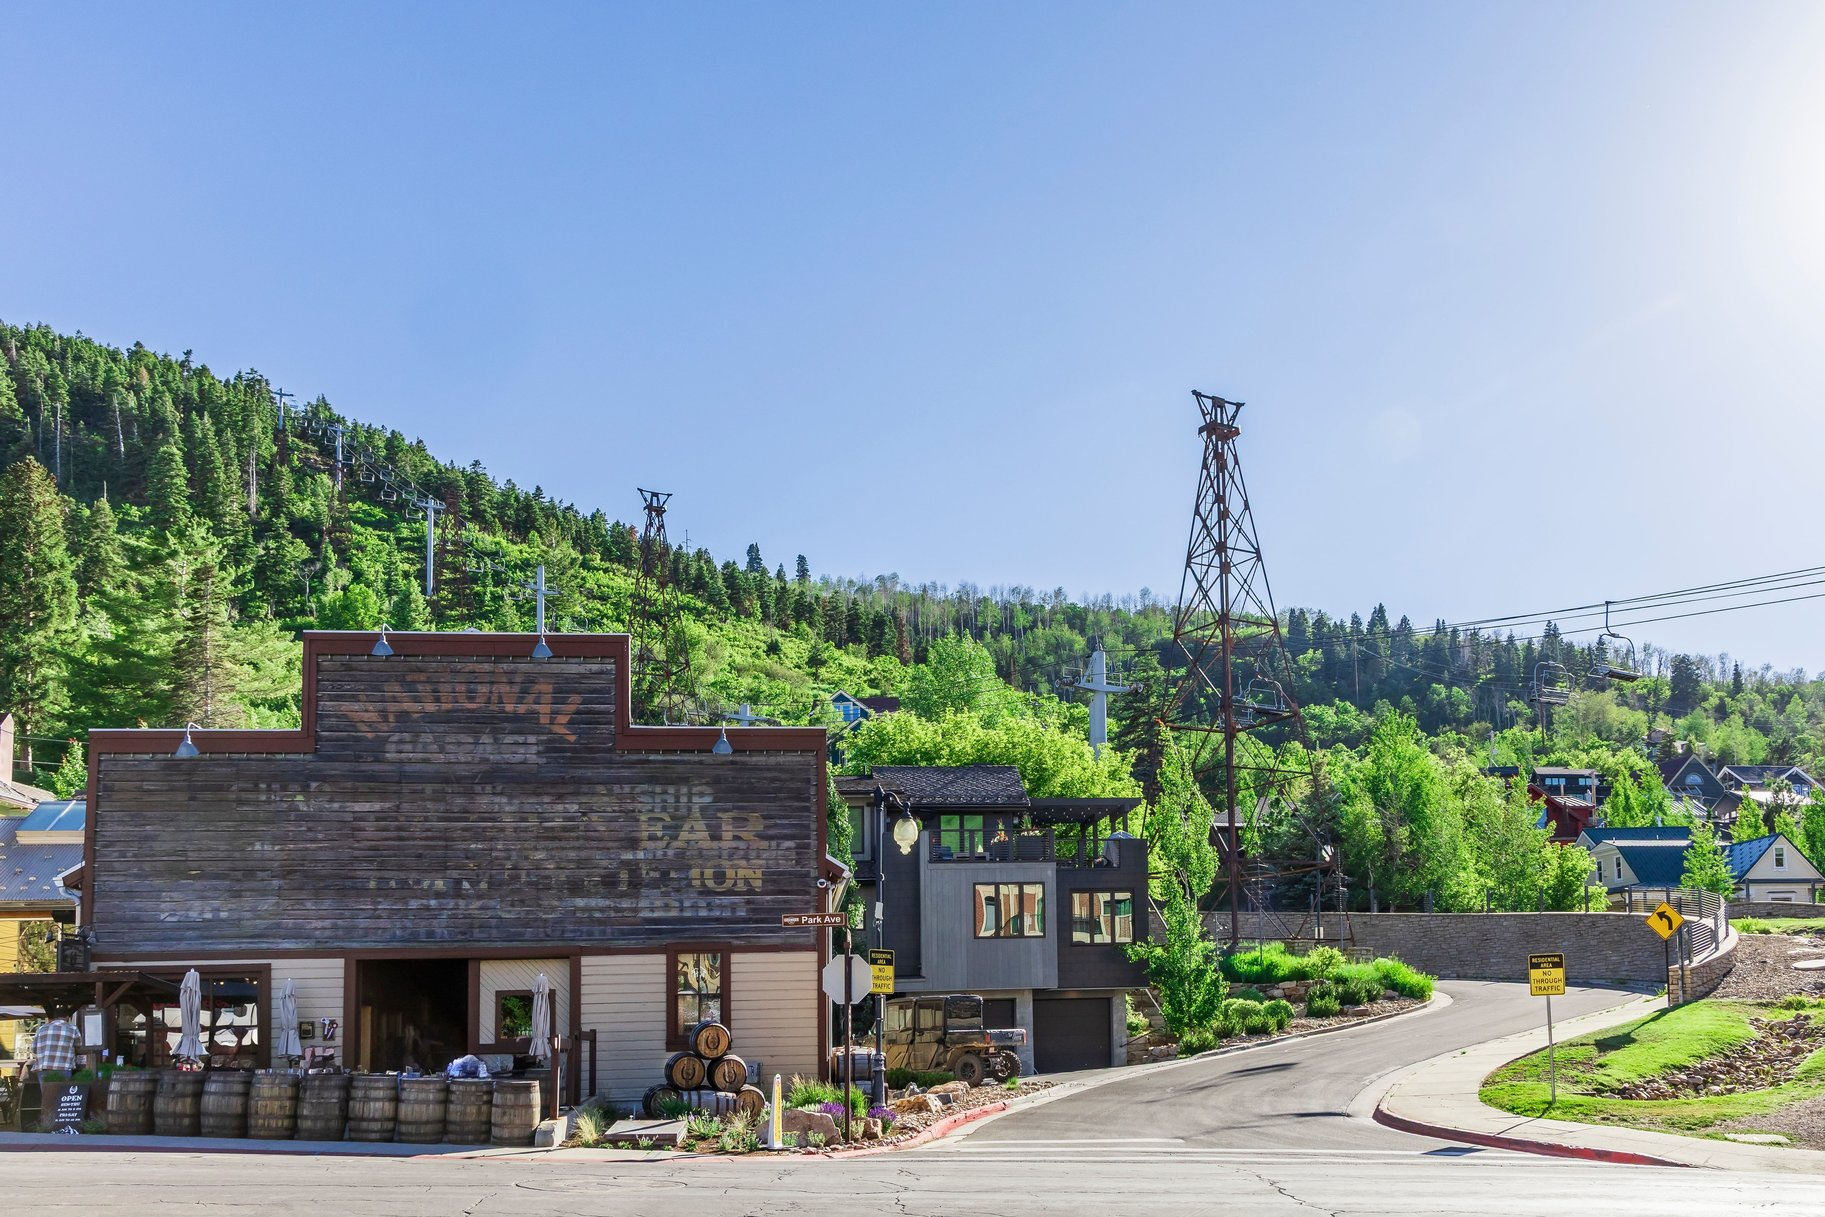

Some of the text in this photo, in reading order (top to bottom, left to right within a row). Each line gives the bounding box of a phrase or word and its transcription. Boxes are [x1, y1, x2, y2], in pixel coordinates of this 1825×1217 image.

[801, 916, 822, 924] Park
[823, 915, 841, 923] Ave
[61, 1094, 83, 1102] OPEN
